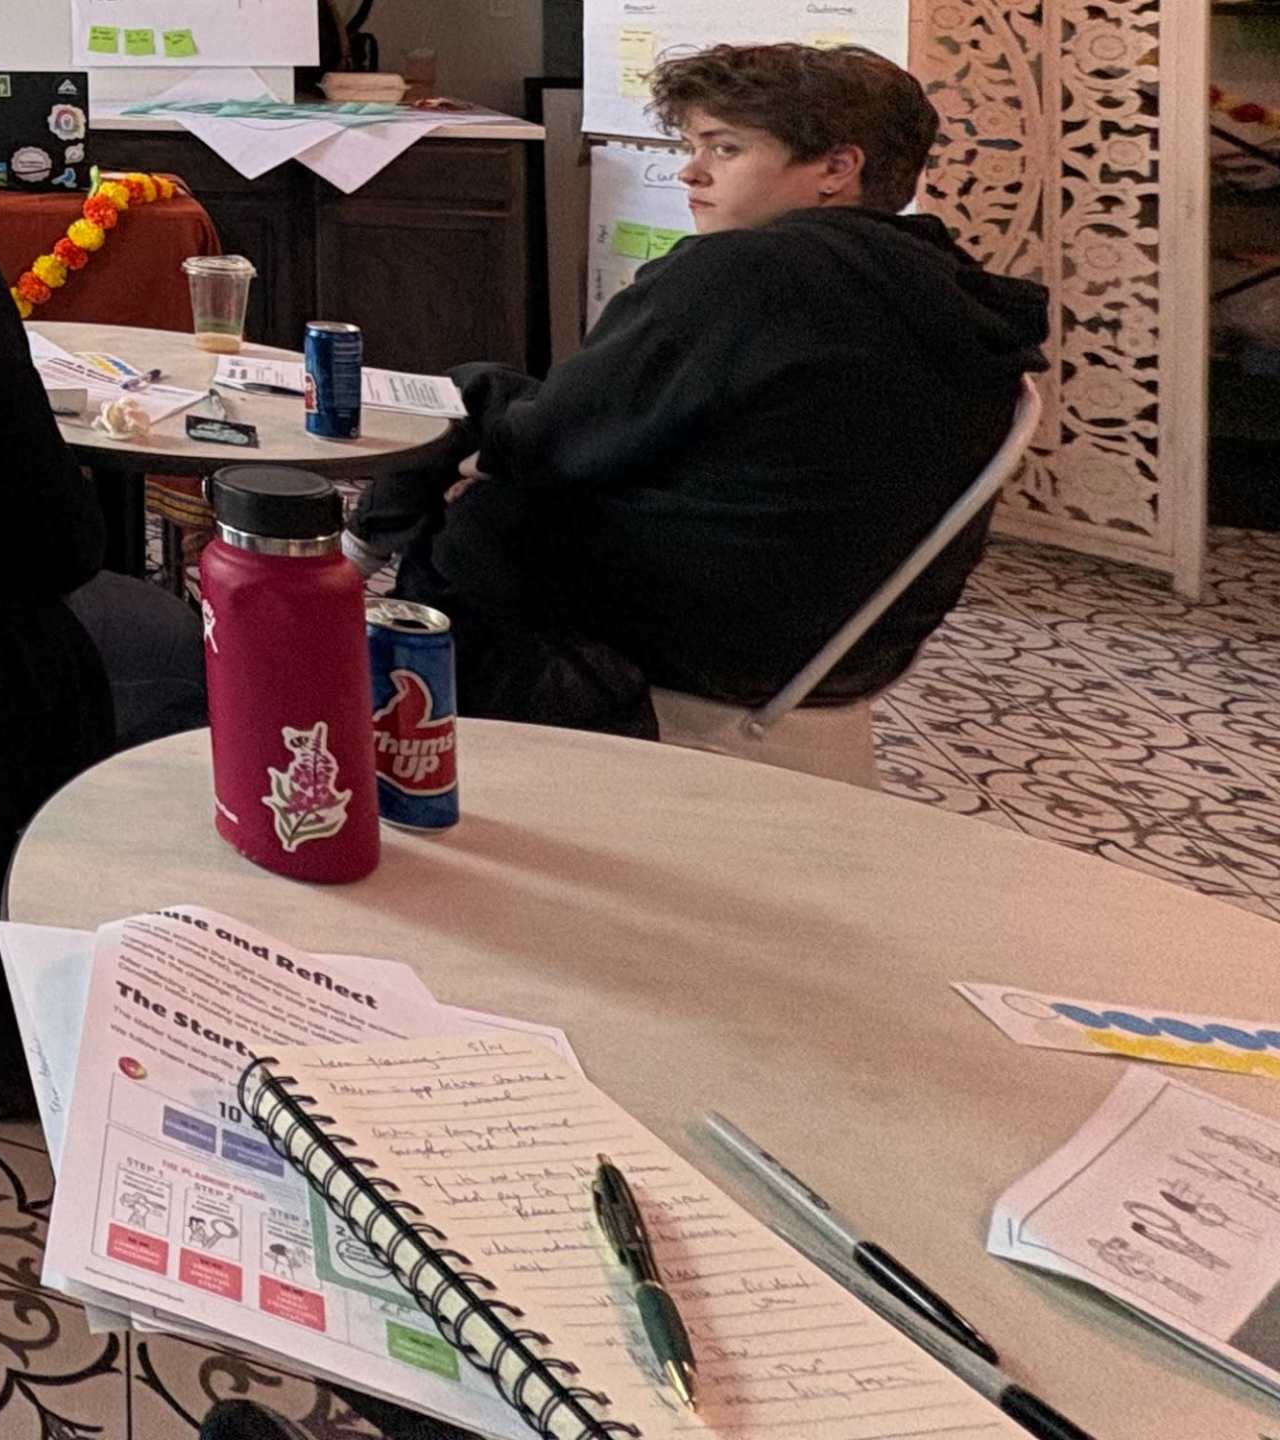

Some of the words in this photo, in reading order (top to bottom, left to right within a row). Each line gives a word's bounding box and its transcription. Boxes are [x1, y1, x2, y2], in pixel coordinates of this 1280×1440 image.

[215, 928, 270, 961] and
[276, 954, 378, 1010] Reflect
[115, 980, 168, 1018] The
[218, 1100, 243, 1123] 10
